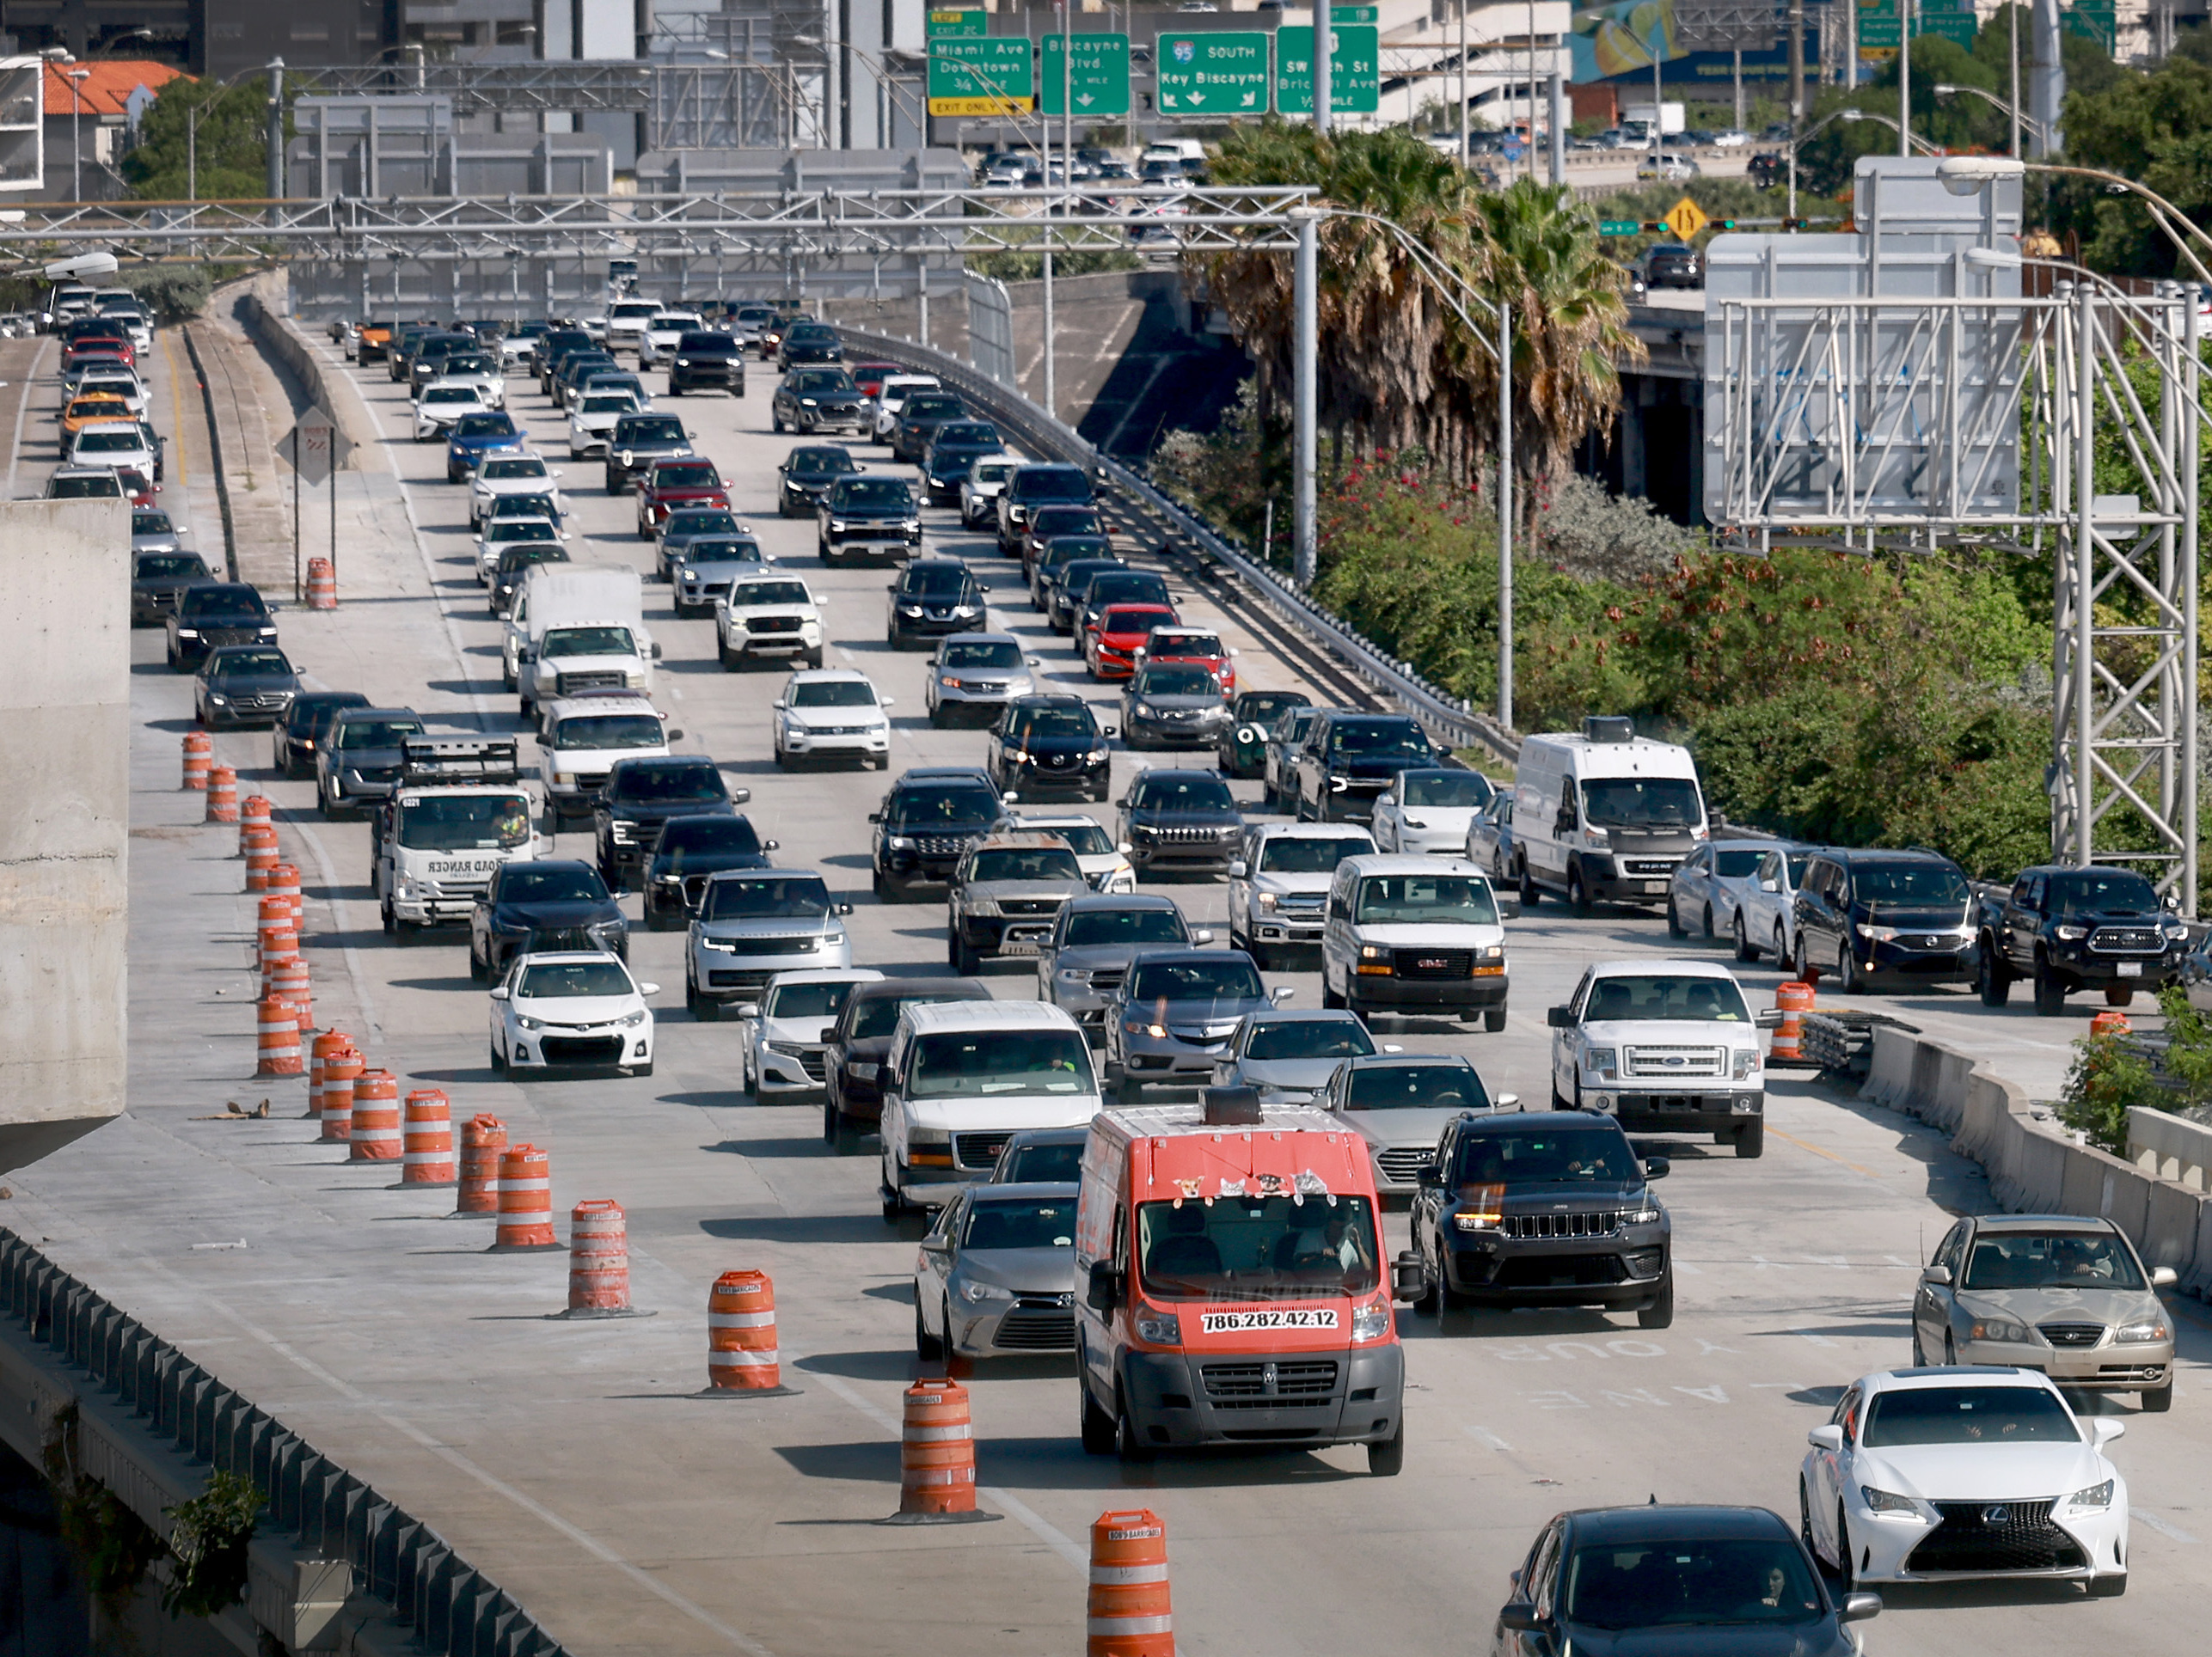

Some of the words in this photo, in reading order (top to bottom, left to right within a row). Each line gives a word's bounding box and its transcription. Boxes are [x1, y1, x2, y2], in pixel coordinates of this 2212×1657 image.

[936, 44, 983, 56] Miami
[996, 43, 1024, 54] Ave
[1174, 46, 1192, 60] 95
[1208, 46, 1255, 58] SOUTH
[941, 61, 1020, 73] Downtown
[1286, 60, 1308, 73] SW
[1353, 60, 1369, 72] St
[1161, 72, 1189, 87] Key
[1196, 71, 1265, 87] Biscayne
[1349, 78, 1376, 89] Ave
[936, 103, 960, 113] EXIT
[966, 103, 996, 113] ONLY
[1204, 1312, 1335, 1330] 786.282.42.12
[1482, 1337, 1744, 1360] YOUR
